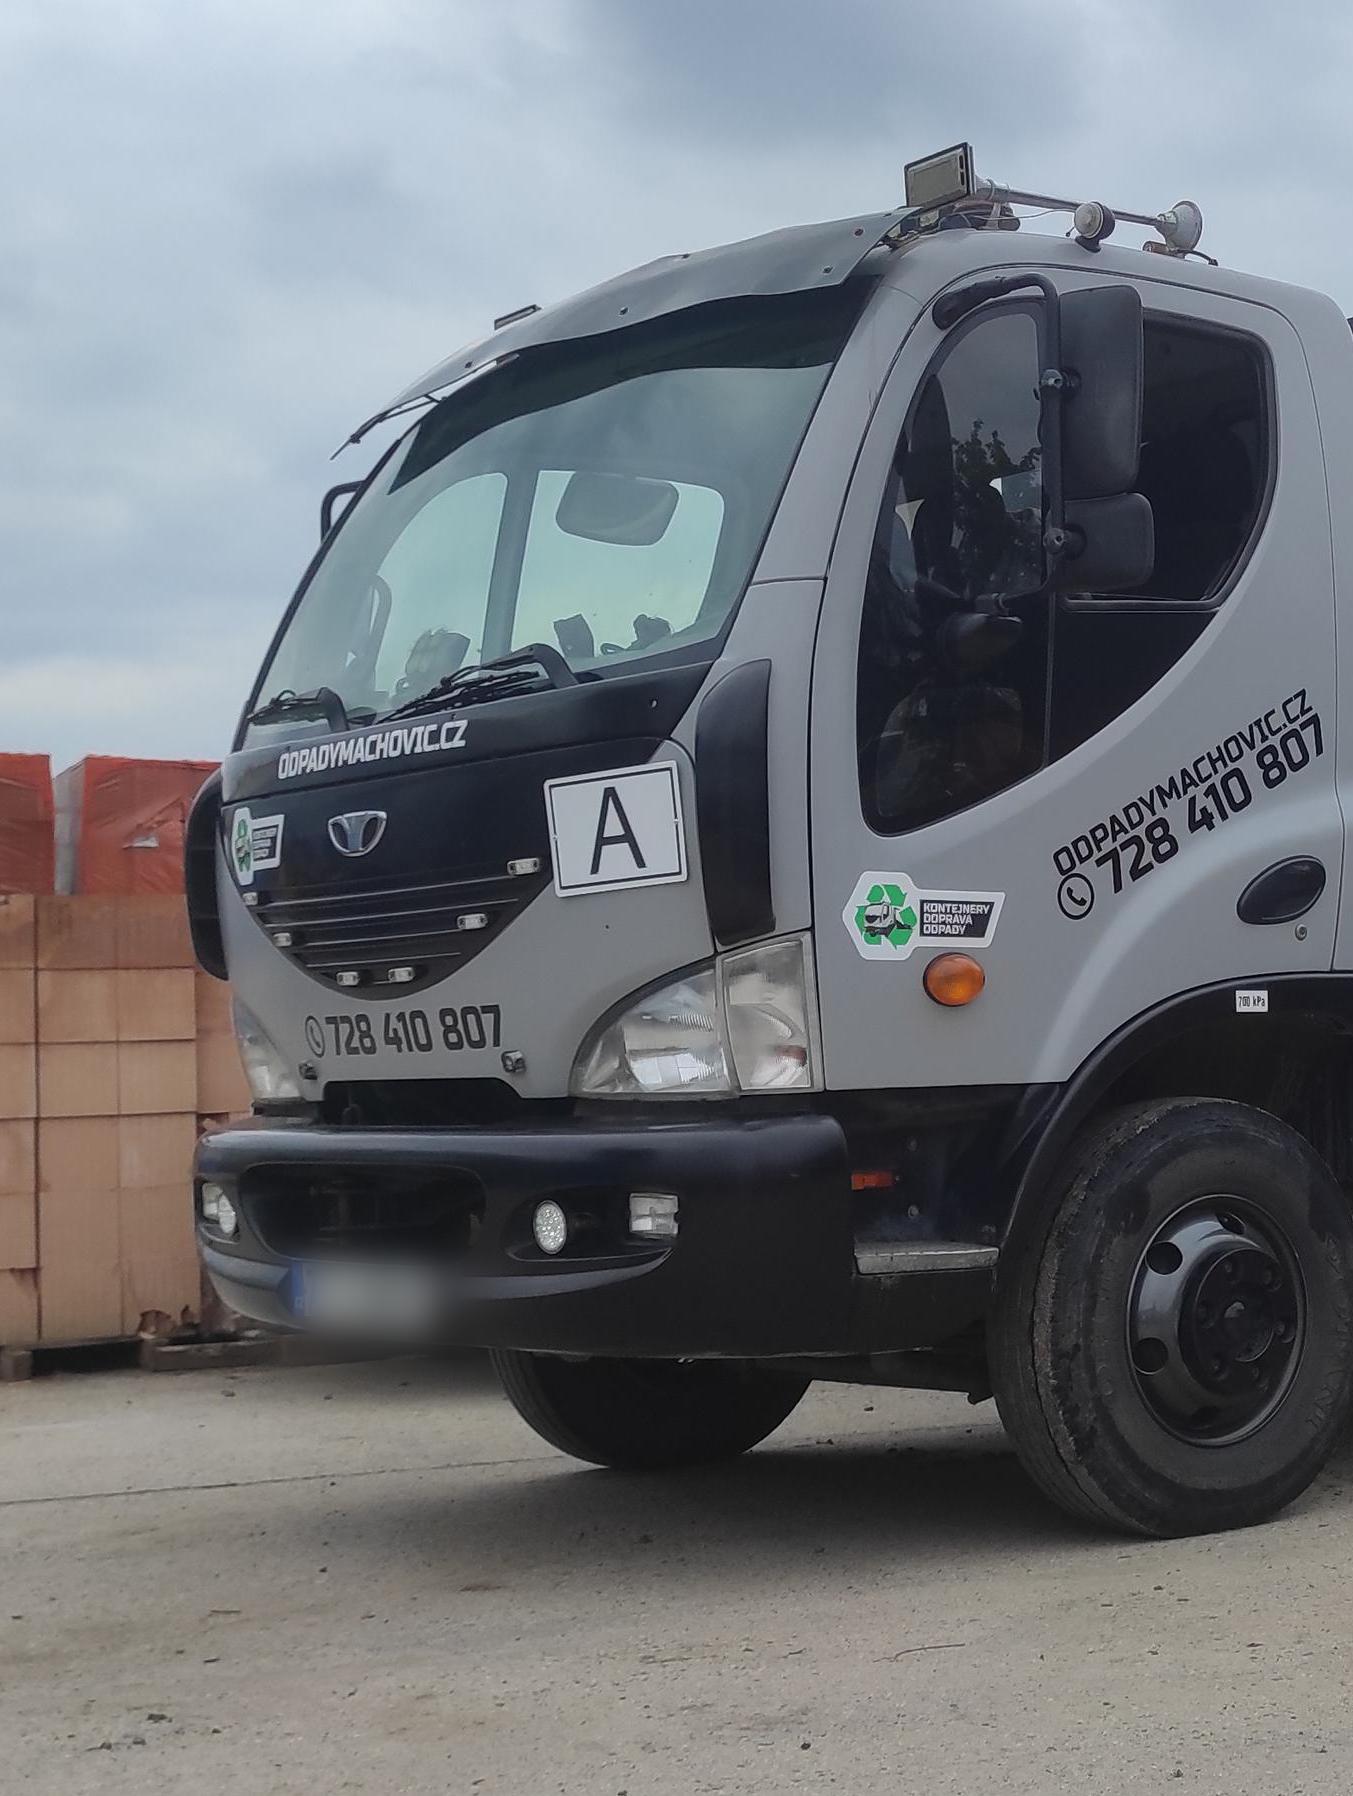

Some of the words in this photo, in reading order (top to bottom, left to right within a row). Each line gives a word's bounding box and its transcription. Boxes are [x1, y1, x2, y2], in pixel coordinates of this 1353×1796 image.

[277, 719, 469, 780] ODPADYMACHOVIC.CZ
[1053, 688, 1314, 876] ODPADYMACHOVIC.CZ
[1094, 816, 1179, 894] 728
[1187, 766, 1252, 834] 410
[1255, 712, 1324, 790] 807
[590, 786, 647, 875] A
[923, 903, 991, 915] KONTEJNERY
[923, 913, 973, 925] DOPRAVA
[923, 923, 967, 935] ODPADY
[325, 1013, 377, 1056] 728
[383, 1009, 433, 1053] 410
[439, 1004, 501, 1051] 807
